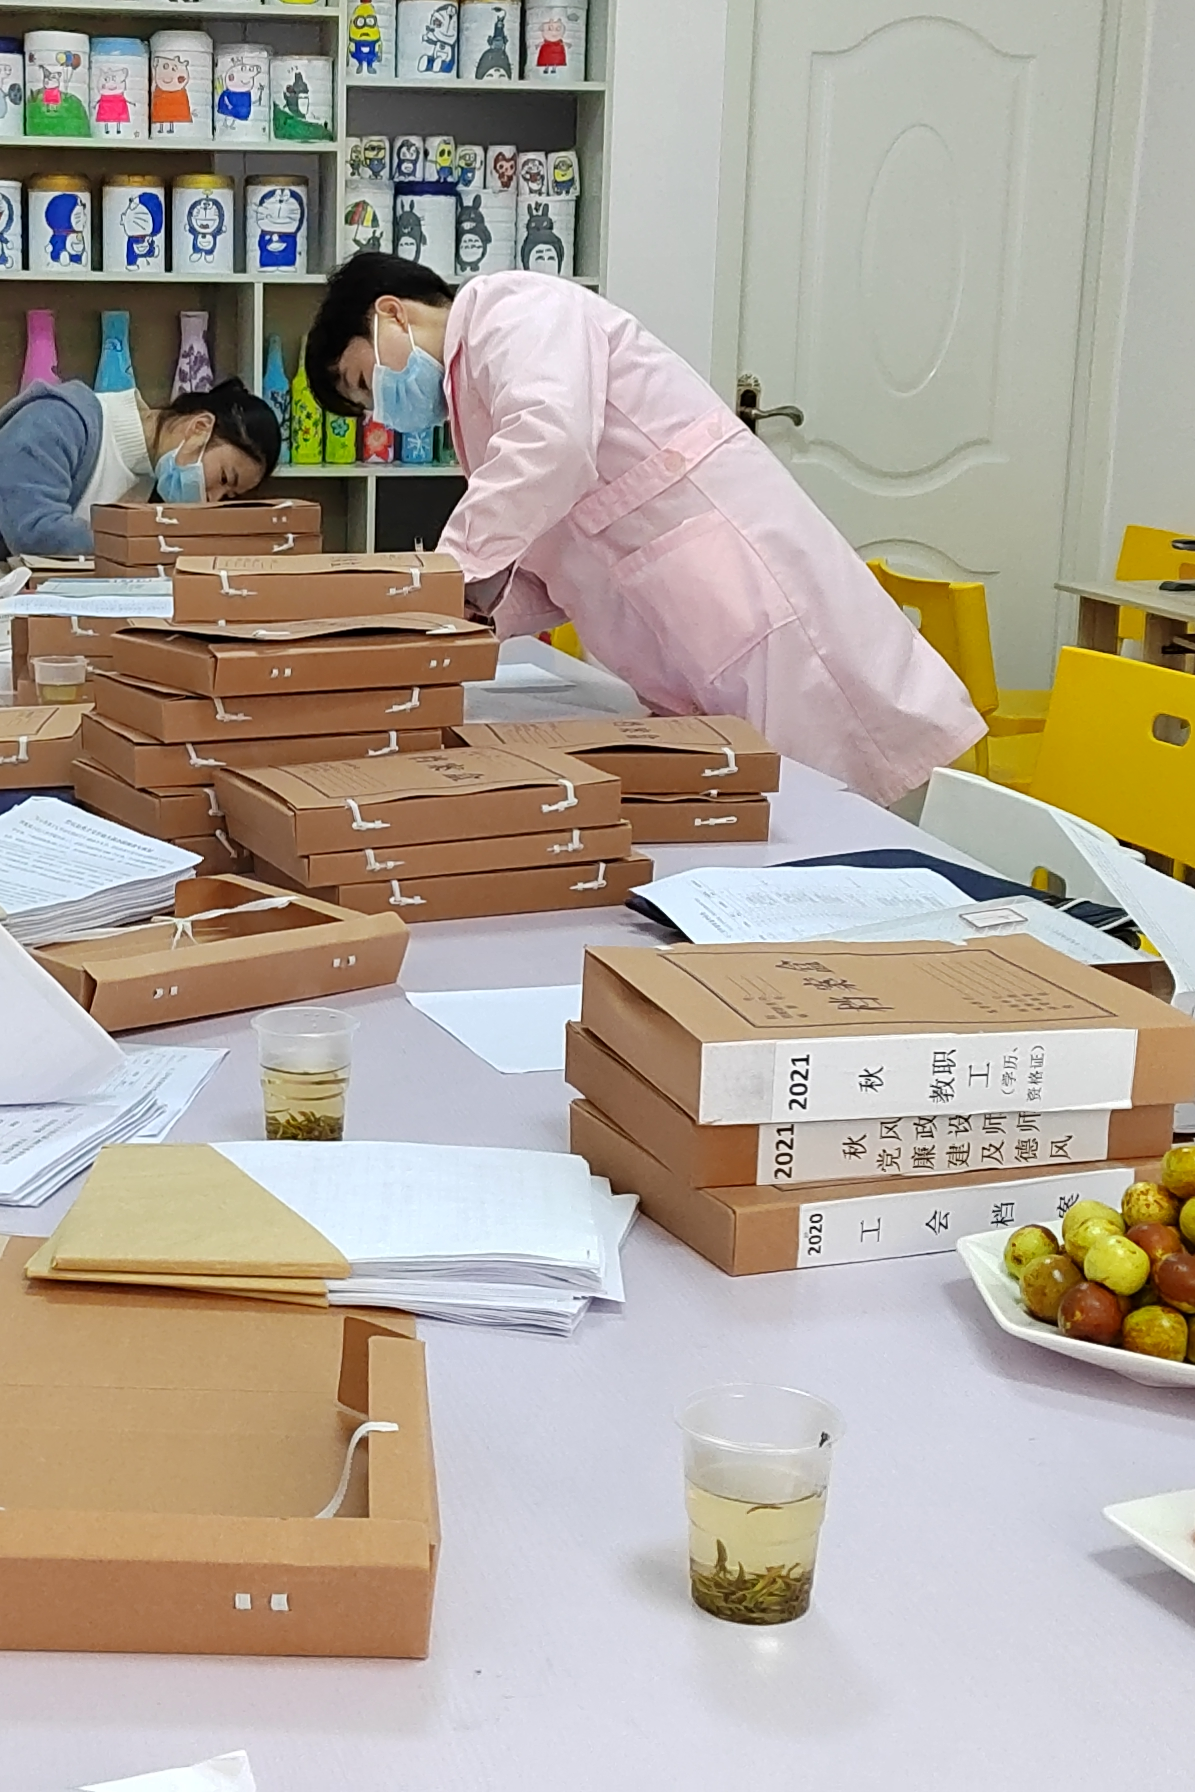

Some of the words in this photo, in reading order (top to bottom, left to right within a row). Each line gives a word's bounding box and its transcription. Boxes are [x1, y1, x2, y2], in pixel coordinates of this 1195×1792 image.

[774, 960, 895, 1013] 档案盒
[788, 1054, 810, 1111] 2021
[858, 1065, 884, 1093] 秋
[928, 1048, 957, 1105] 教职
[968, 1061, 991, 1088] 工
[773, 1123, 795, 1180] 2021
[842, 1133, 867, 1160] 秋
[876, 1117, 903, 1173] 党风
[911, 1115, 938, 1170] 廉政
[946, 1114, 972, 1168] 建设
[1049, 1134, 1073, 1160] 风
[807, 1213, 824, 1256] 2020
